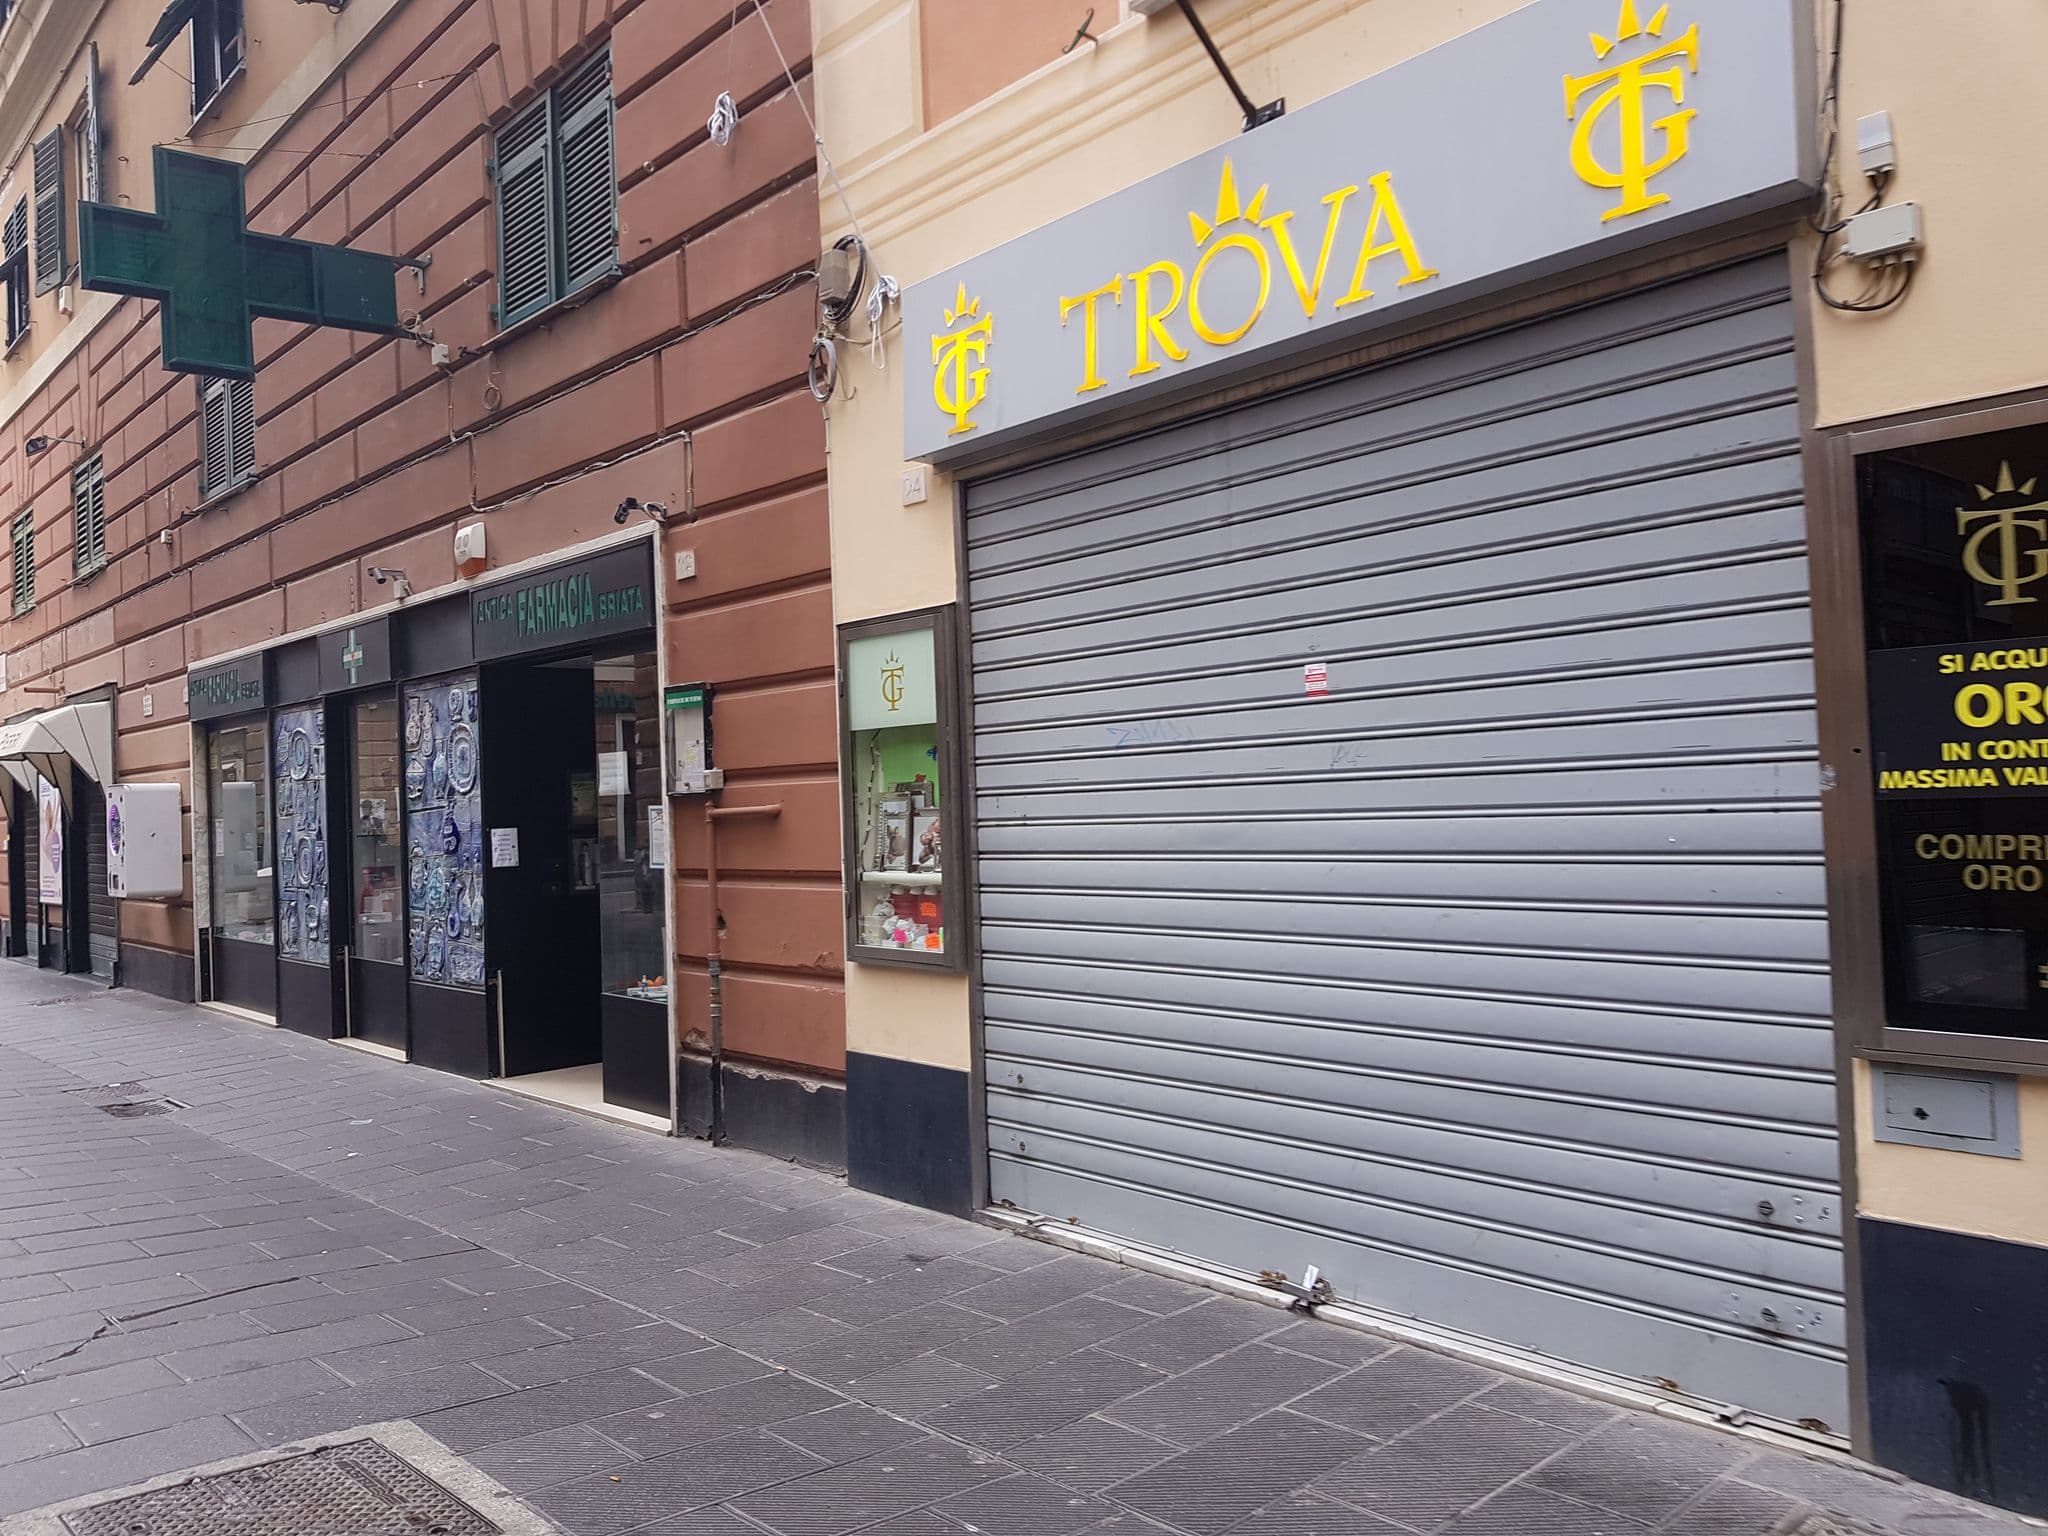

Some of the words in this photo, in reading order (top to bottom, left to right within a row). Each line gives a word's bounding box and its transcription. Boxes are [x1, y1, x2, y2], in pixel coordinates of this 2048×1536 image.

[1059, 171, 1440, 394] TROVA
[477, 593, 513, 624] ANTICA
[516, 572, 595, 637] FARMACIA
[598, 585, 645, 622] BRIATA
[1938, 654, 1965, 674] SI
[1954, 681, 2048, 728] OR
[1941, 742, 1972, 761] IN
[1879, 768, 2000, 789] MASSIMA
[1915, 833, 2048, 861] COMPR
[1963, 864, 2044, 892] ORO
